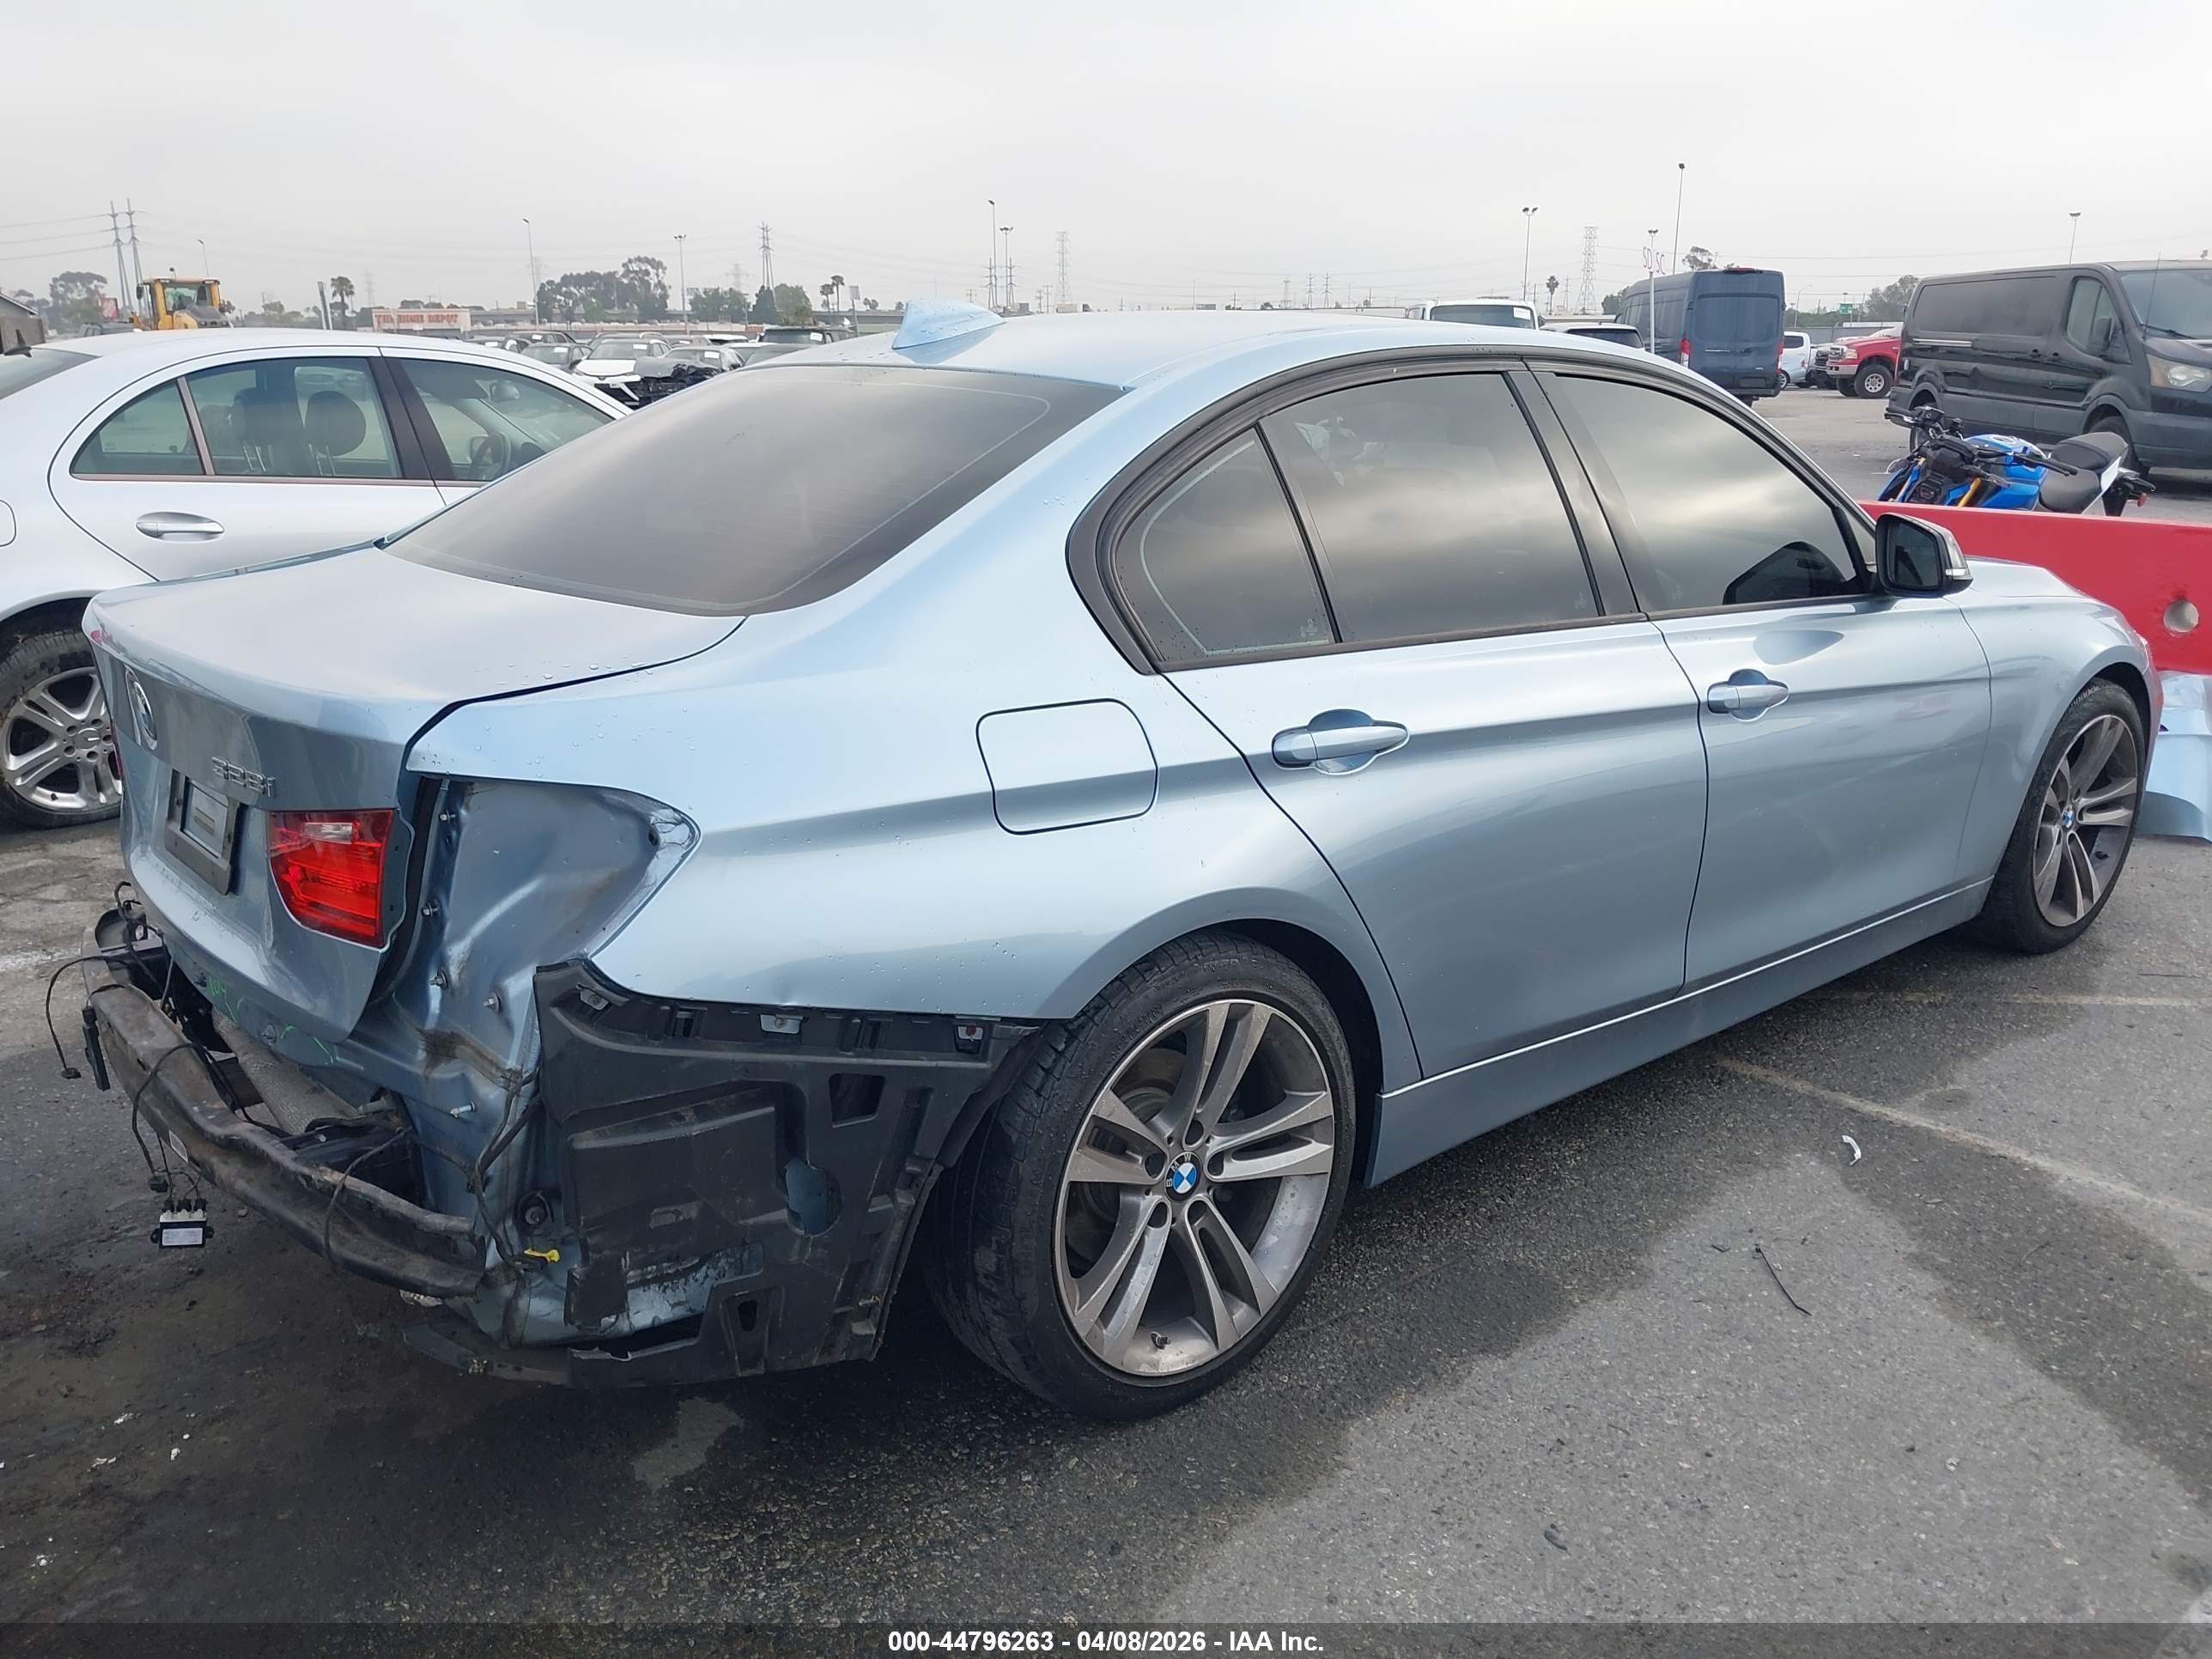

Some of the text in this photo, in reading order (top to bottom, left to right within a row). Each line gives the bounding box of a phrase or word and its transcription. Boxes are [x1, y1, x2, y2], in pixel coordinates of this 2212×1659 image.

[1643, 246, 1666, 276] SD SC
[211, 757, 276, 799] 328i
[1166, 1152, 1192, 1188] BMW
